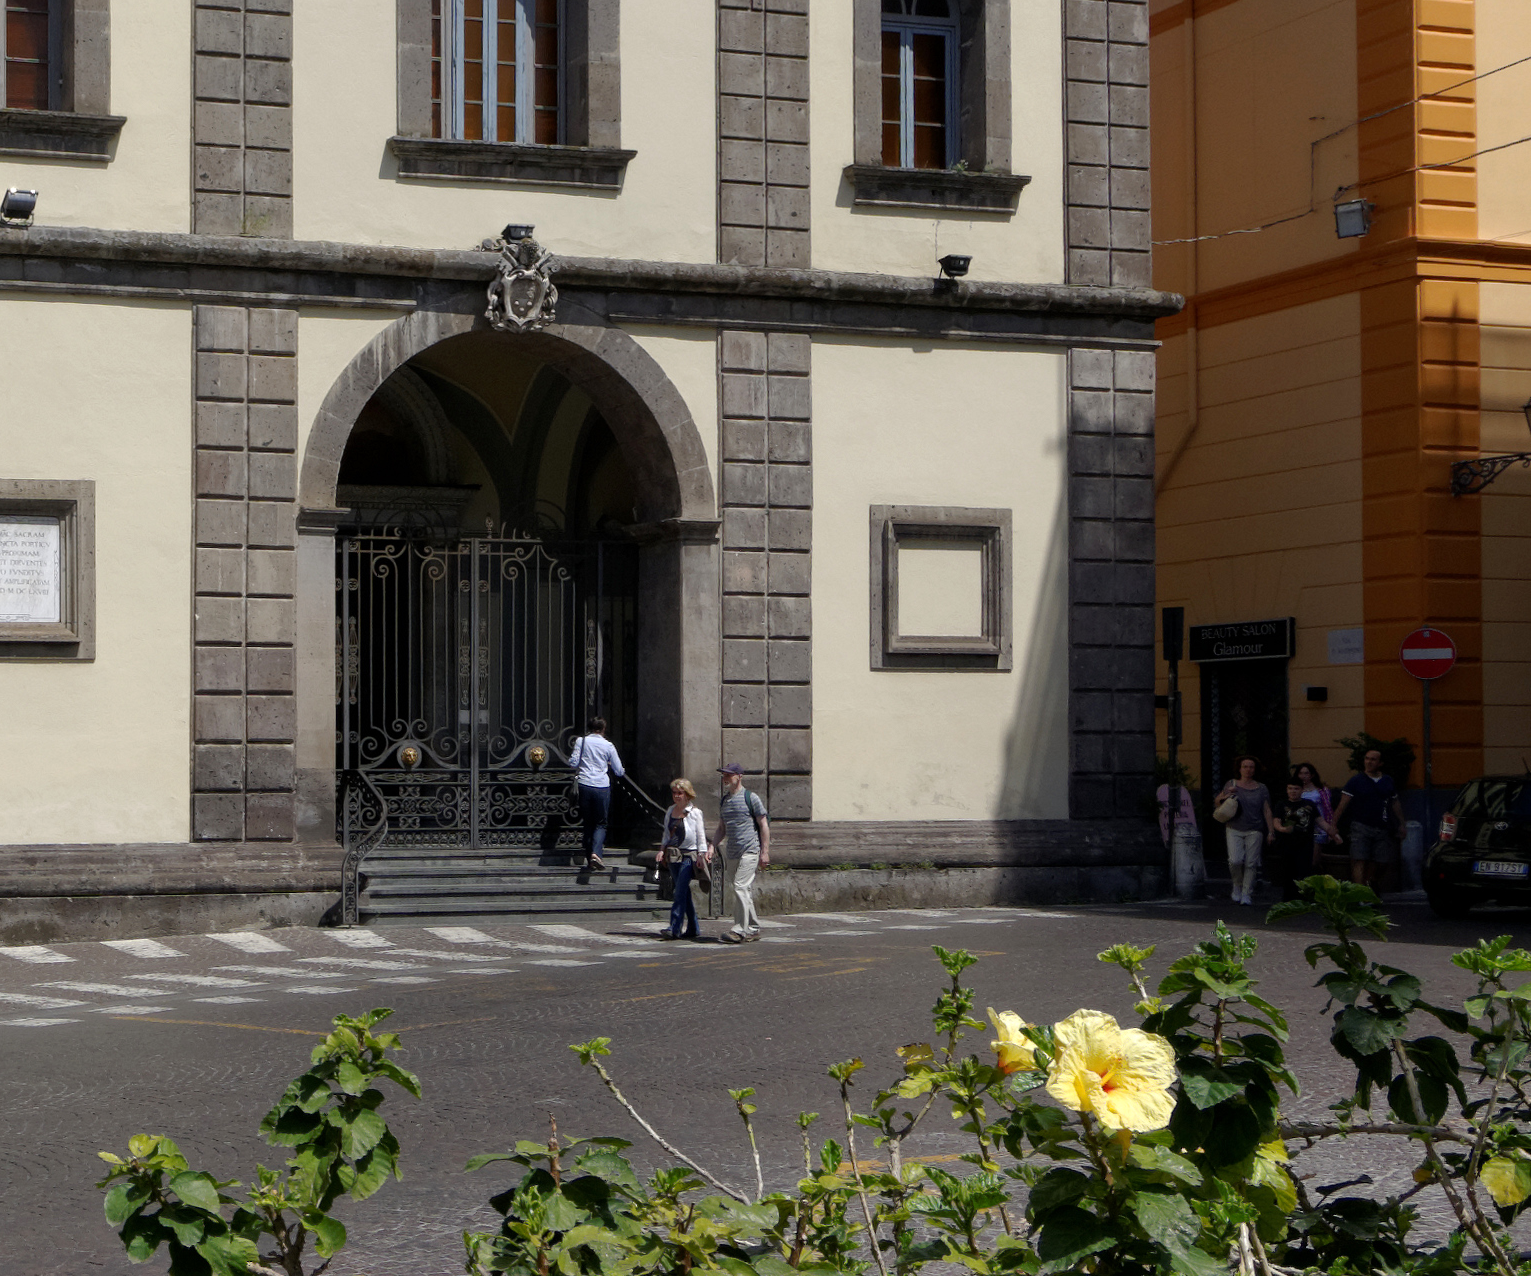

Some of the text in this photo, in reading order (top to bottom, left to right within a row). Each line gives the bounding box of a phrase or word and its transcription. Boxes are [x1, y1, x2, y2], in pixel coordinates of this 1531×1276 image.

[1201, 623, 1277, 640] BEAUTY SALON
[1213, 641, 1264, 656] Glamour
